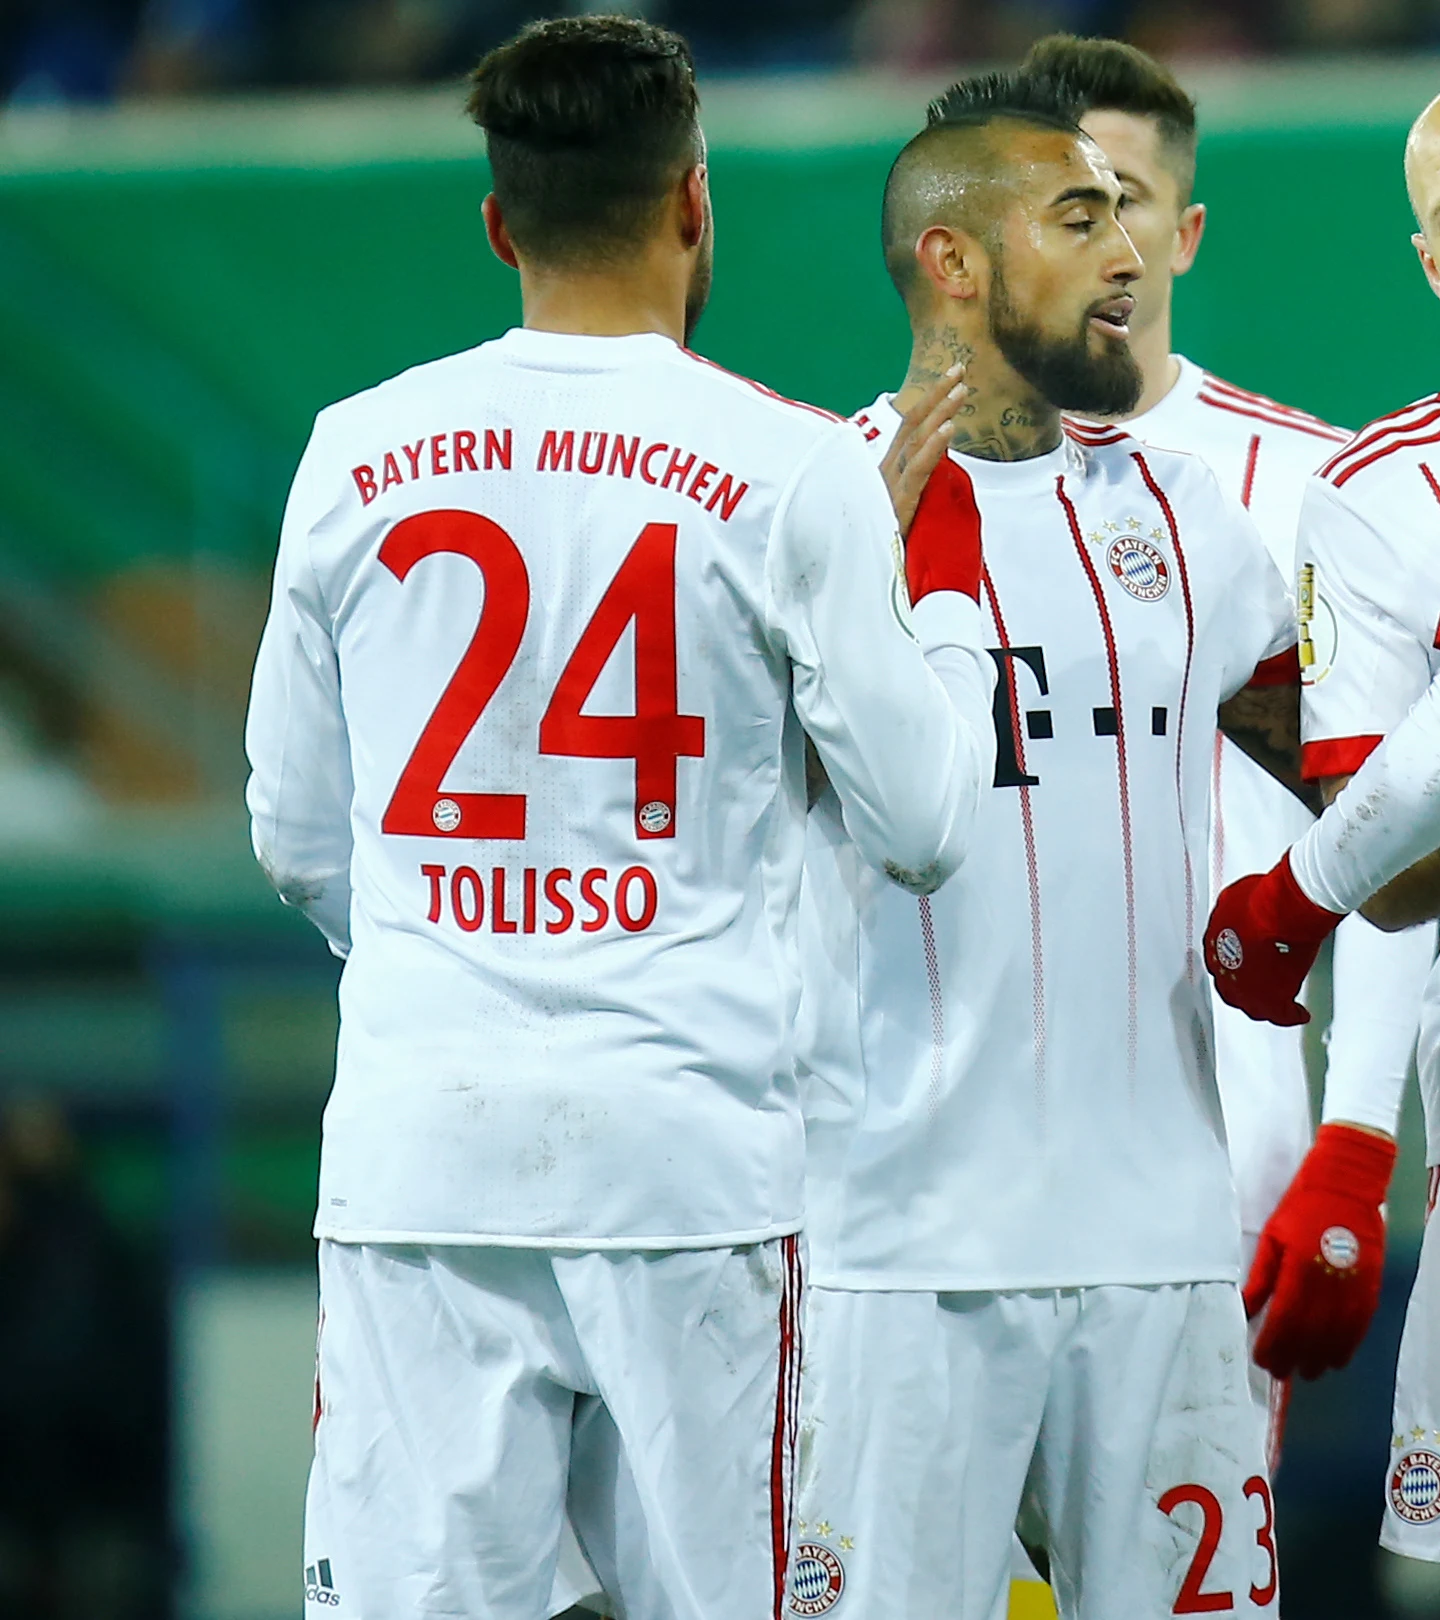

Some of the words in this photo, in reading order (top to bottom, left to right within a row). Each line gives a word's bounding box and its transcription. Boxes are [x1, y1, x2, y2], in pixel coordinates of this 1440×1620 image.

[349, 428, 514, 508] BAYERN
[536, 430, 750, 523] MÜNCHEN
[1118, 539, 1163, 565] BAYERN
[377, 508, 706, 841] 24
[420, 863, 658, 935] TOLISSO
[1157, 1475, 1278, 1616] 23
